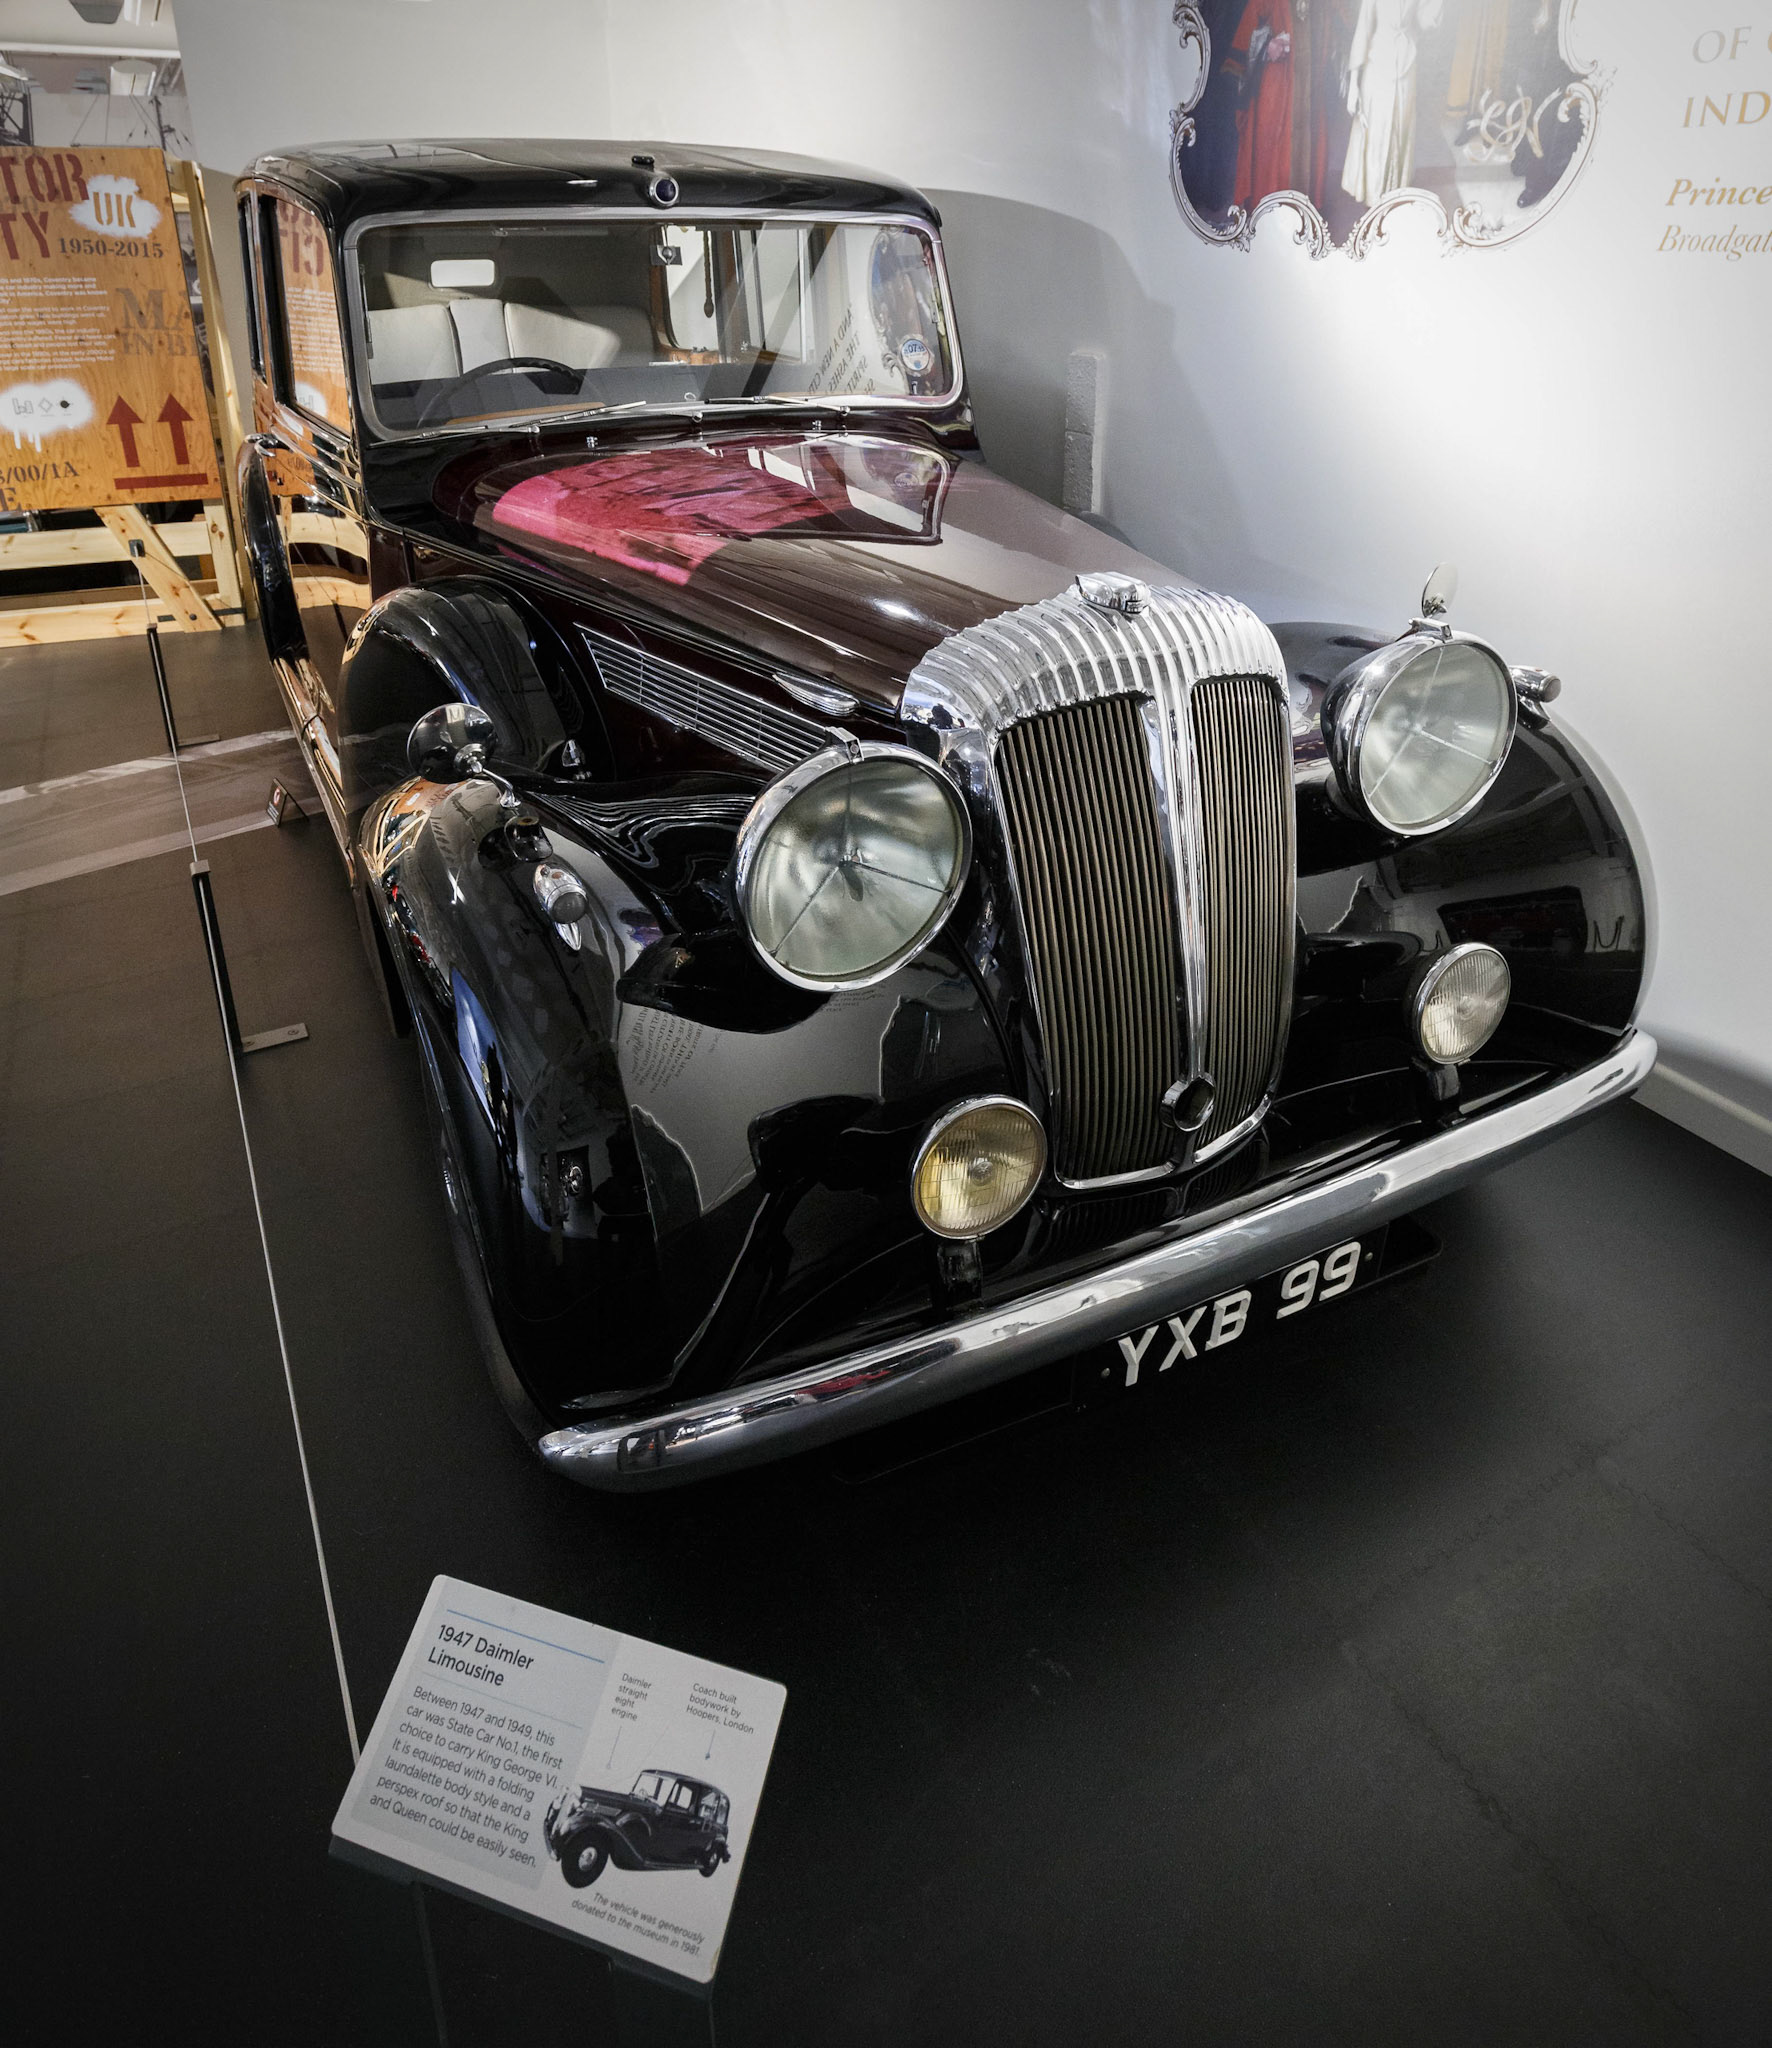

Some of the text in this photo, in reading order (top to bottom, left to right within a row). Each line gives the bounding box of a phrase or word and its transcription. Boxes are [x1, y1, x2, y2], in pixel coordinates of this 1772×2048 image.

[1692, 25, 1752, 64] OF
[1683, 90, 1772, 128] IND
[0, 153, 90, 204] TOR
[1664, 176, 1772, 206] Prince
[93, 191, 136, 228] UK
[58, 237, 164, 258] 1950-2015
[1656, 223, 1772, 262] Broadgat
[1117, 1241, 1362, 1387] YXB 99
[428, 1647, 505, 1686] Limousine
[438, 1624, 535, 1670] 1947 Daimler
[618, 1685, 648, 1701] straight
[622, 1673, 651, 1689] Daimler
[692, 1683, 737, 1705] Coach built
[413, 1686, 555, 1747] Between 1947 and 1949, this
[611, 1708, 637, 1722] engine
[615, 1696, 635, 1709] eight
[686, 1705, 754, 1735] Hoopers, London
[689, 1694, 741, 1719] bodywork by
[399, 1722, 558, 1789] choice to carry King George VI.
[406, 1705, 564, 1770] car was State Car No.1, the first
[384, 1756, 531, 1821] laundalette body style and a
[392, 1737, 535, 1803] It is equipped with a folding
[376, 1776, 529, 1843] perspex roof so that the King
[369, 1794, 537, 1868] and Queen could be easily seen.
[571, 1899, 607, 1919] donated
[607, 1913, 617, 1923] to
[617, 1917, 633, 1929] the
[633, 1925, 669, 1944] museum
[670, 1939, 679, 1948] in
[593, 1892, 705, 1944] The vehicle was generously
